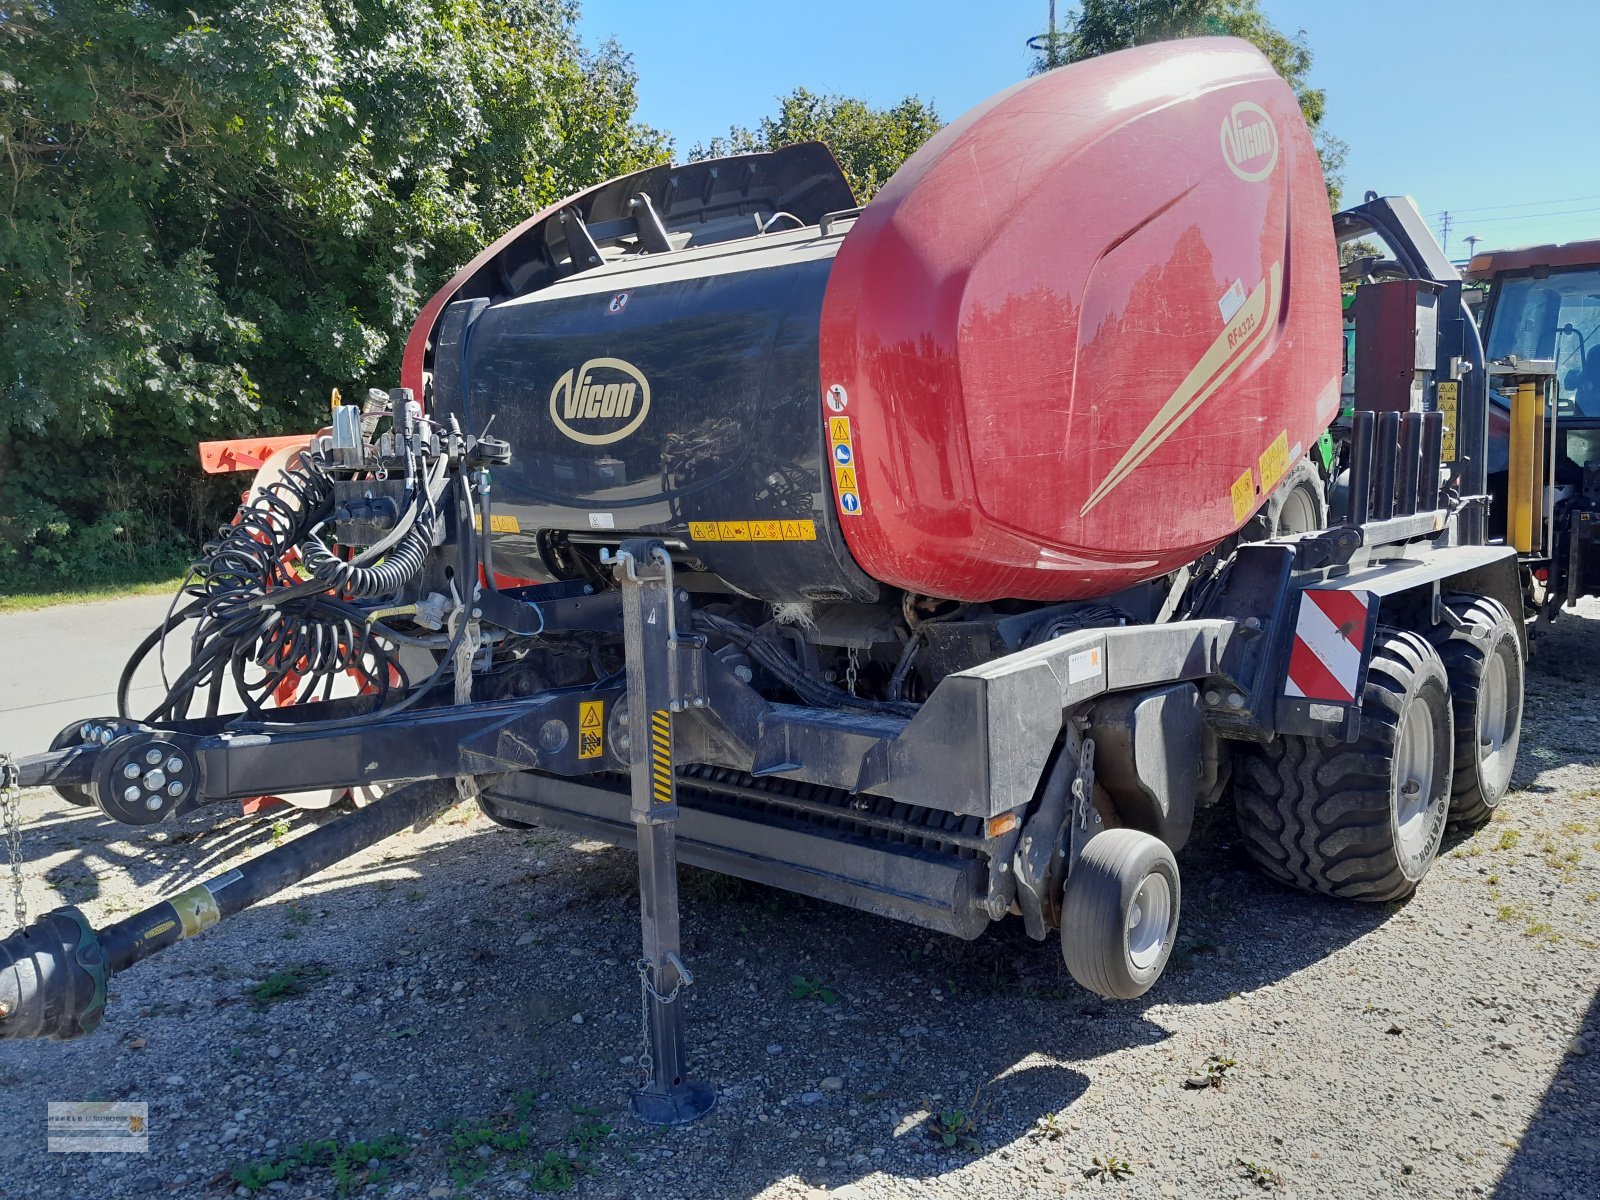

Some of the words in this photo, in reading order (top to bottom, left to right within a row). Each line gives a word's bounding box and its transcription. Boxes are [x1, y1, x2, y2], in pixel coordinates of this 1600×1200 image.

[1223, 104, 1273, 167] Vicon
[1227, 313, 1255, 349] RF4325
[560, 358, 640, 422] Vicon
